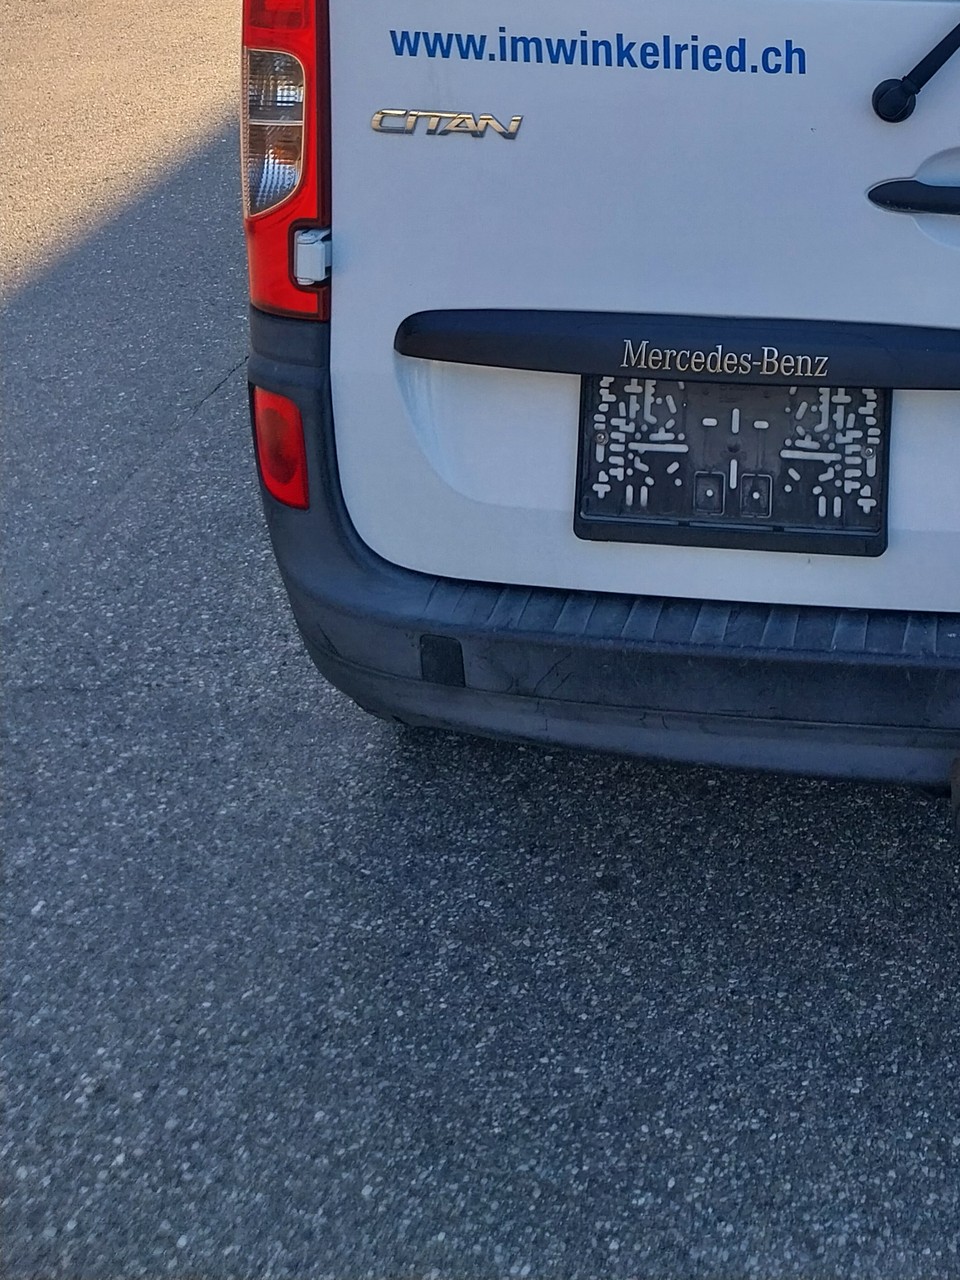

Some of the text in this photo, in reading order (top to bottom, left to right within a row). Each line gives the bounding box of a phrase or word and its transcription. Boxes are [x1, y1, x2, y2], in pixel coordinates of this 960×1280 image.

[390, 27, 807, 74] www.imwinkelried.ch
[371, 108, 524, 140] CITAN
[620, 339, 830, 377] Mercedes-Benz
